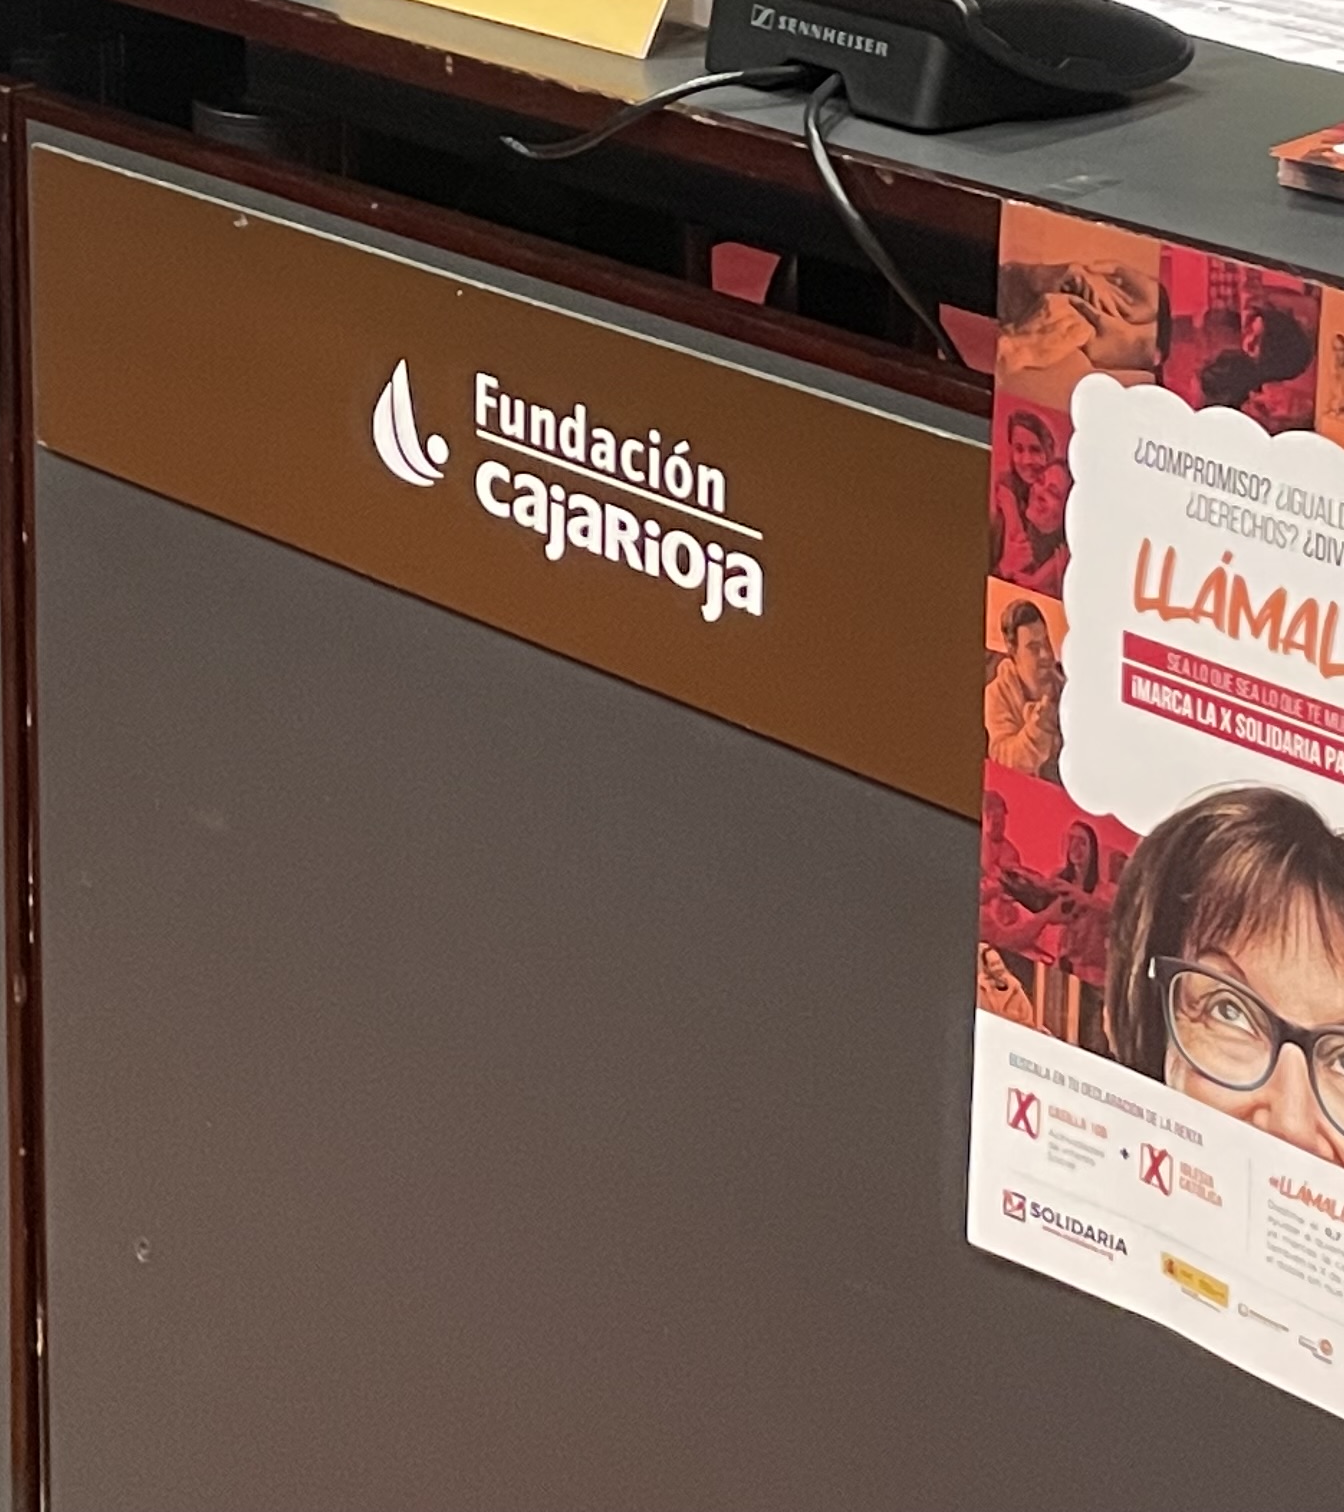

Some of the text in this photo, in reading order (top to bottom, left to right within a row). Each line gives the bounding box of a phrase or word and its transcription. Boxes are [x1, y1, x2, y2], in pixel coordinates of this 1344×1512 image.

[778, 16, 888, 57] SENNHEISER
[475, 372, 726, 512] Fundación
[1134, 437, 1272, 505] ¿COMPROMISO?
[1186, 491, 1299, 550] ¿DERECHOS?
[1167, 652, 1191, 675] SEA
[1192, 660, 1209, 681] LO
[1211, 666, 1234, 690] QUE
[1236, 675, 1260, 699] SEA
[1261, 684, 1278, 706] LO
[1279, 690, 1303, 714] QUE
[1306, 699, 1322, 719] TE
[1131, 674, 1192, 720] ¡MARCA
[1195, 696, 1218, 729] LA
[1219, 703, 1233, 735] X
[1235, 713, 1322, 767] SOLIDARIA
[1030, 1201, 1128, 1256] SOLIDARIA
